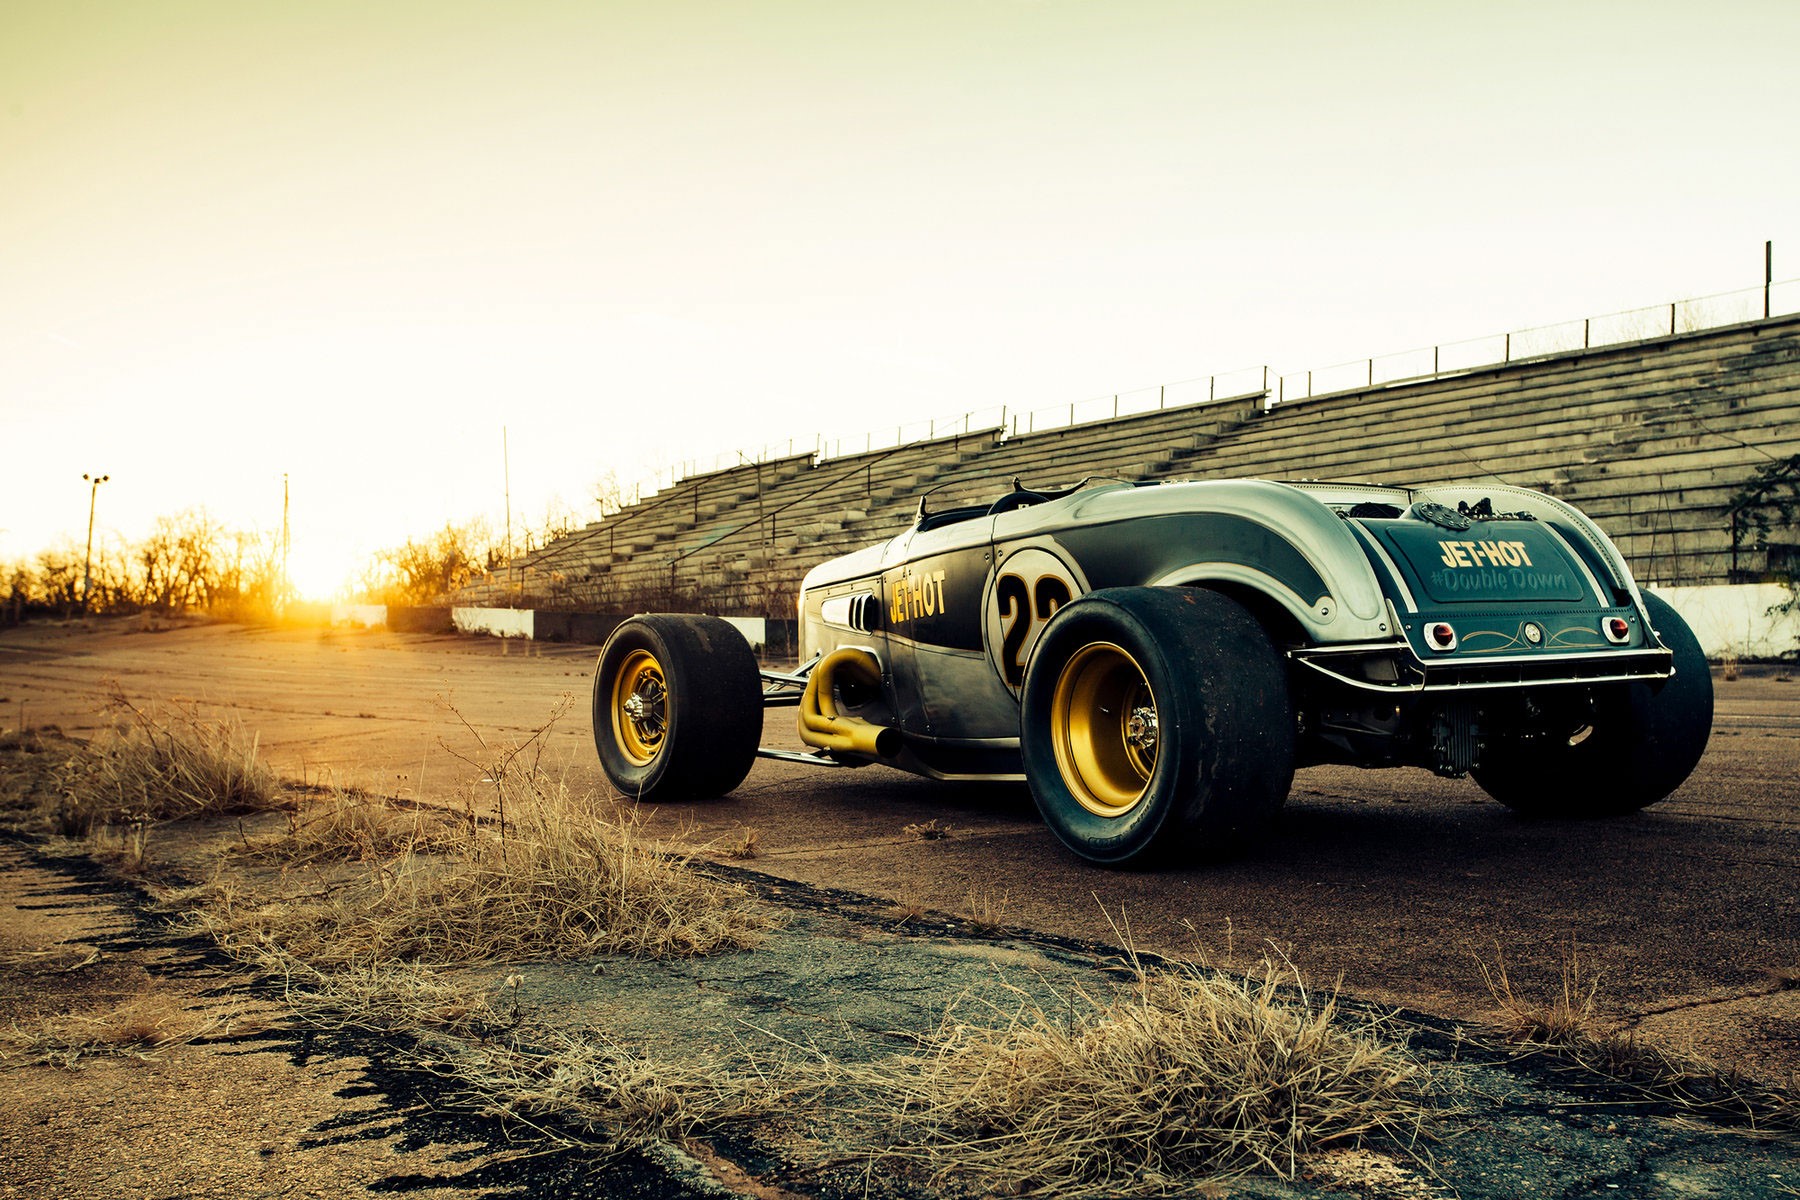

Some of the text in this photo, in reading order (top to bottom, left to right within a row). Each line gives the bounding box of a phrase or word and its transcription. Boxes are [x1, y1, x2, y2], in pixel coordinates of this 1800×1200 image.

[1438, 541, 1533, 568] JET-HOT
[1430, 567, 1567, 592] #Double Down
[890, 569, 946, 624] JET-HOT
